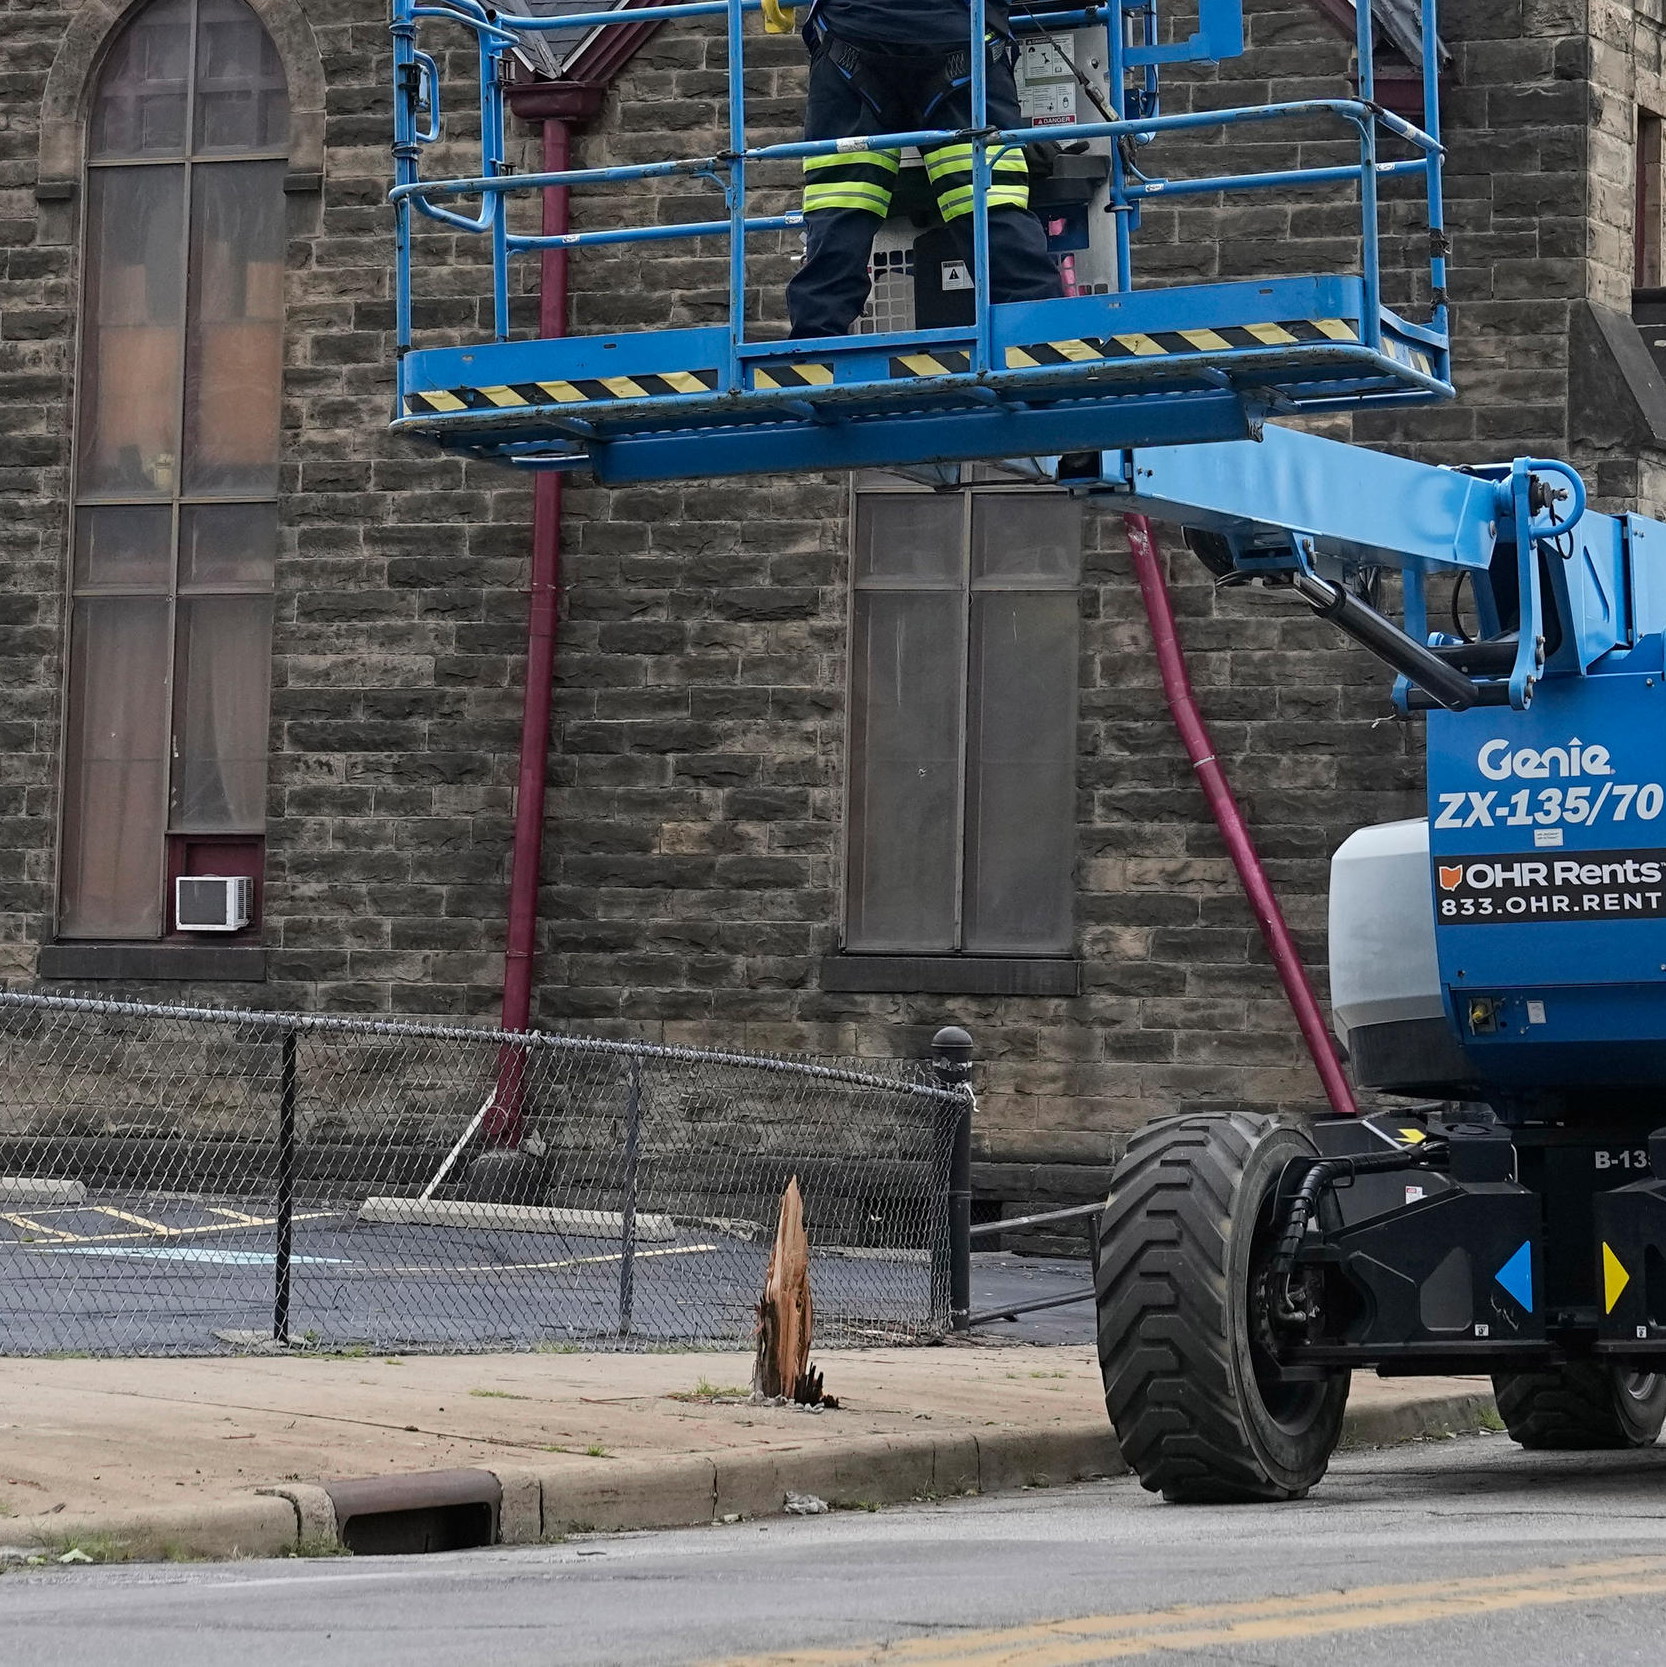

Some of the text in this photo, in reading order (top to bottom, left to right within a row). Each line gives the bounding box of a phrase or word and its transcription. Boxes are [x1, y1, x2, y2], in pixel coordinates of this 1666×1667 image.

[1043, 116, 1071, 124] DANGER
[1477, 737, 1612, 780] Genie
[1434, 782, 1664, 829] ZX-135/70
[1466, 860, 1663, 889] OHR Rents
[1441, 892, 1662, 916] 833.OHR.RENT
[1595, 1150, 1651, 1169] B-13
